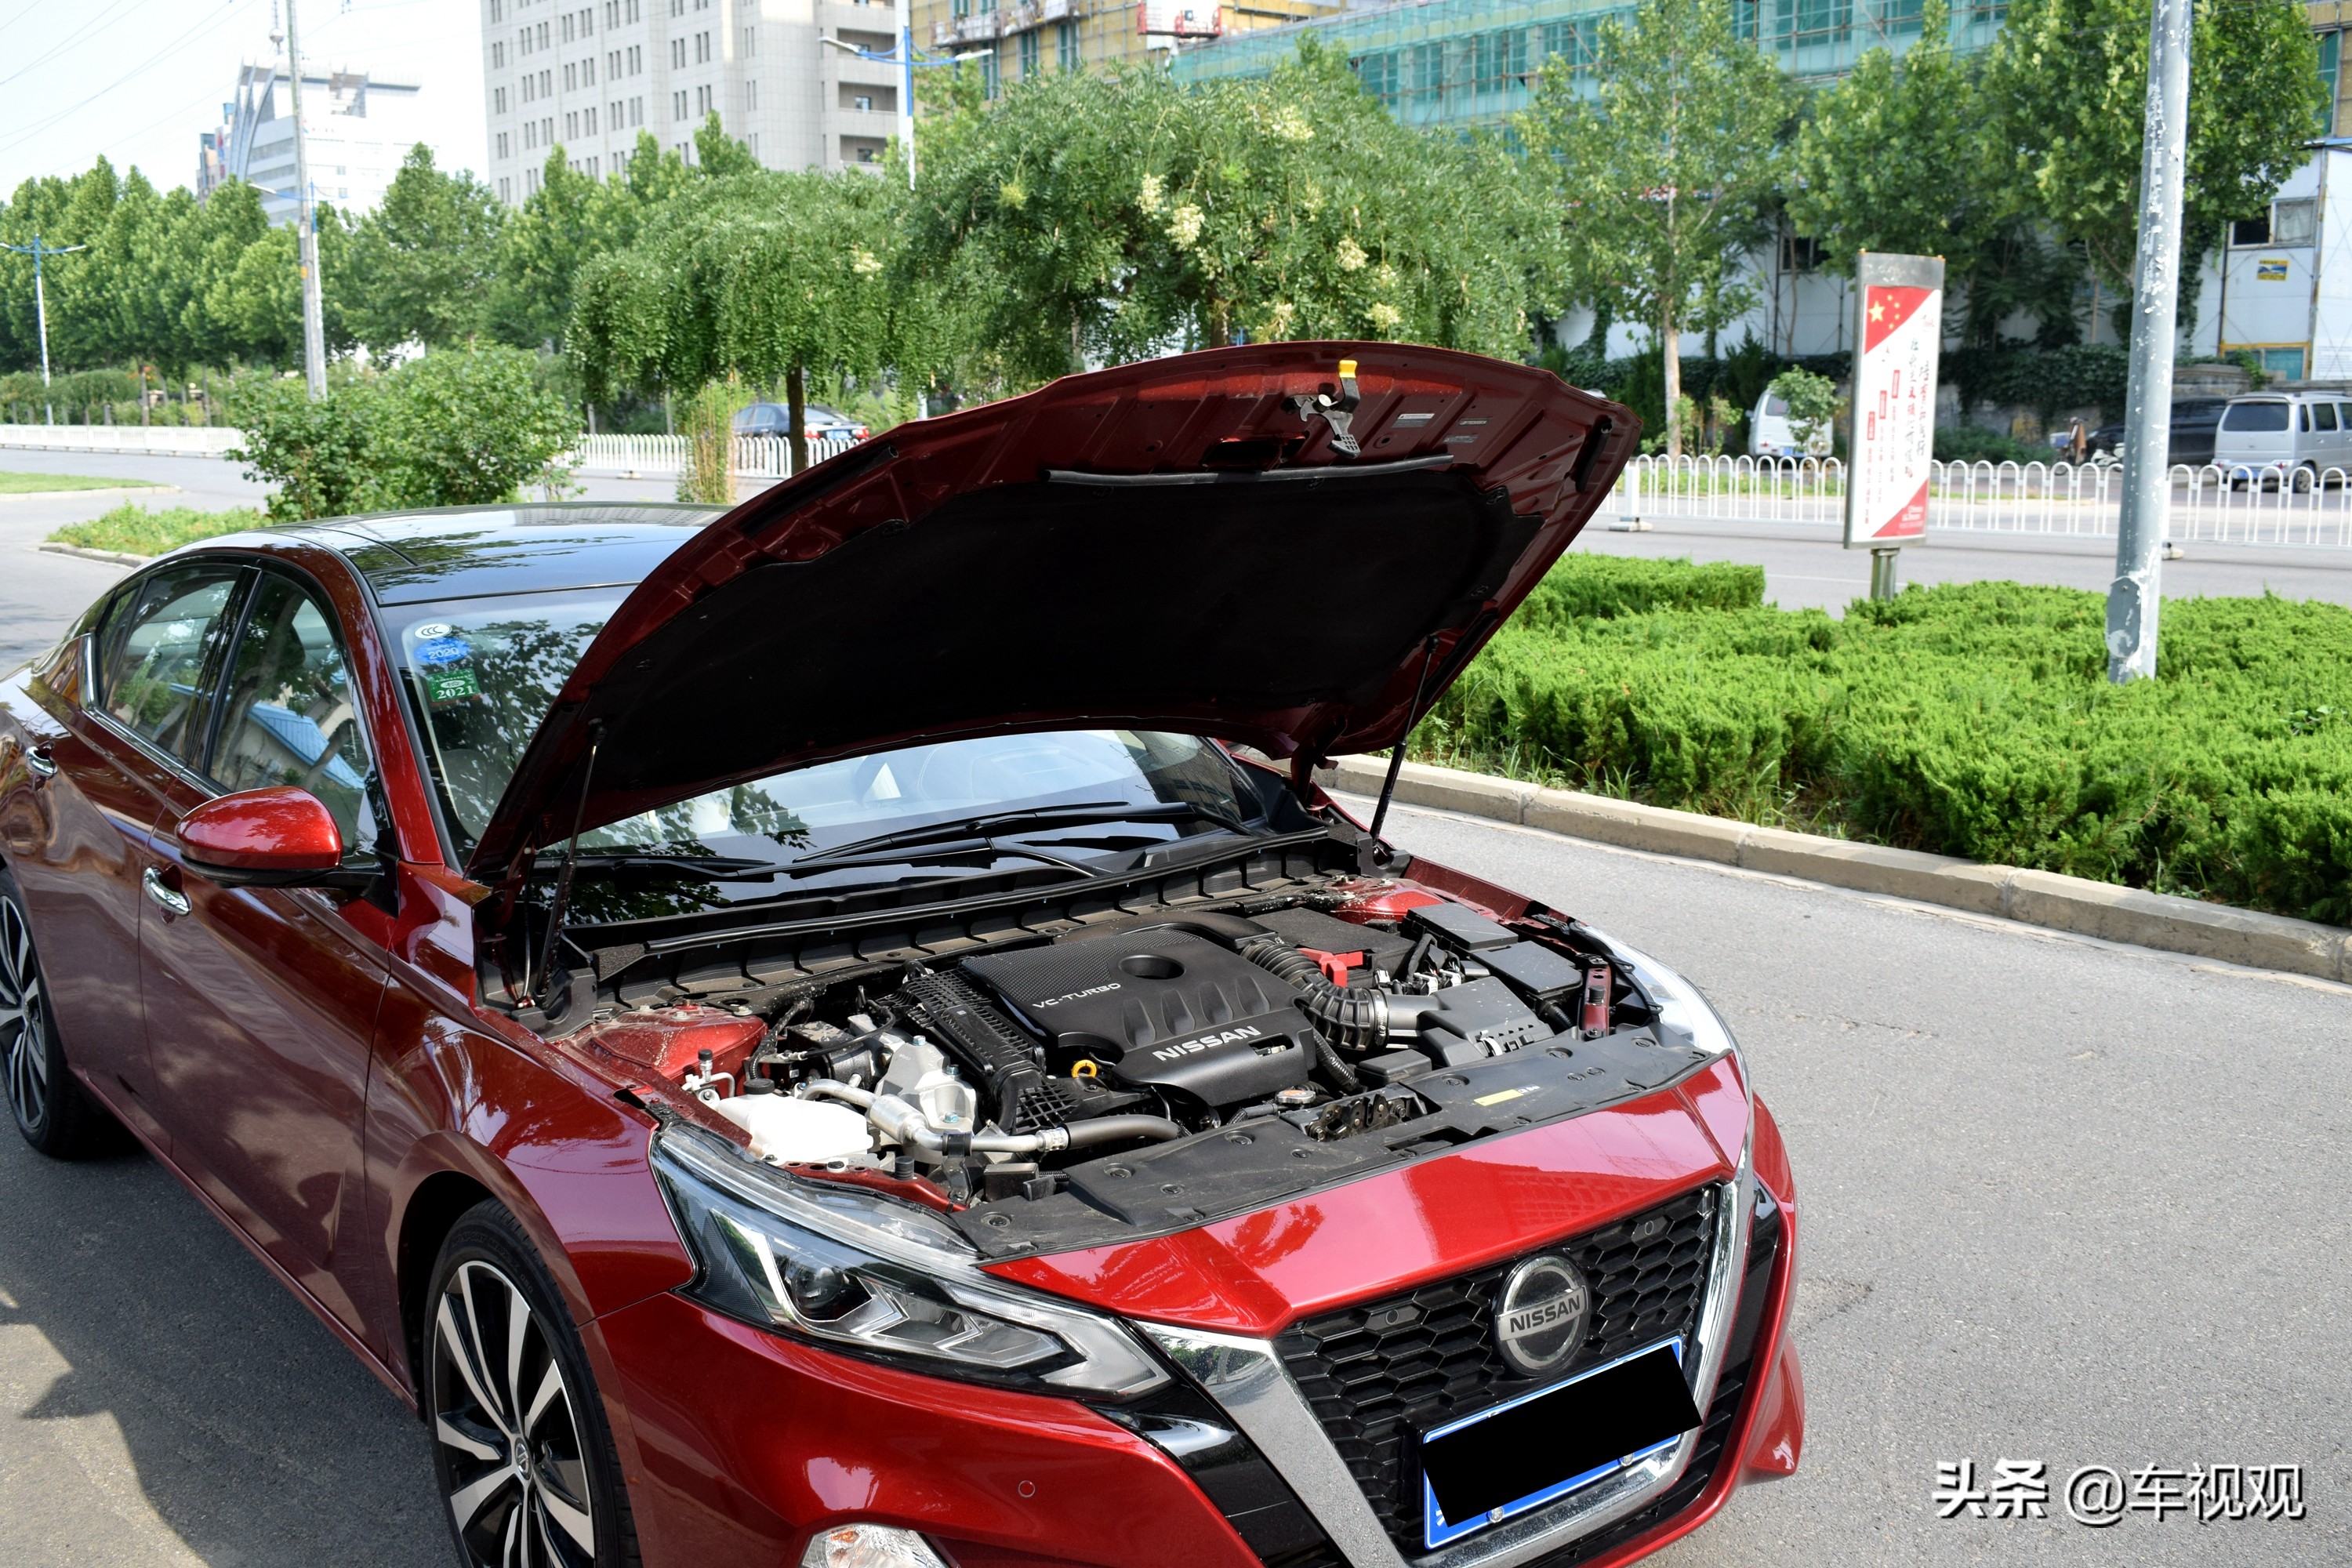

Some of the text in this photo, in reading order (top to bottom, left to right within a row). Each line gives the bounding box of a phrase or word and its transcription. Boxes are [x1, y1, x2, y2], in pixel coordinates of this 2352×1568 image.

[428, 647, 459, 659] 2020
[436, 685, 475, 699] 2021
[1032, 982, 1121, 1008] VC-TURBO
[1152, 1025, 1261, 1062] NISSAN
[1510, 1295, 1581, 1333] NISSAN
